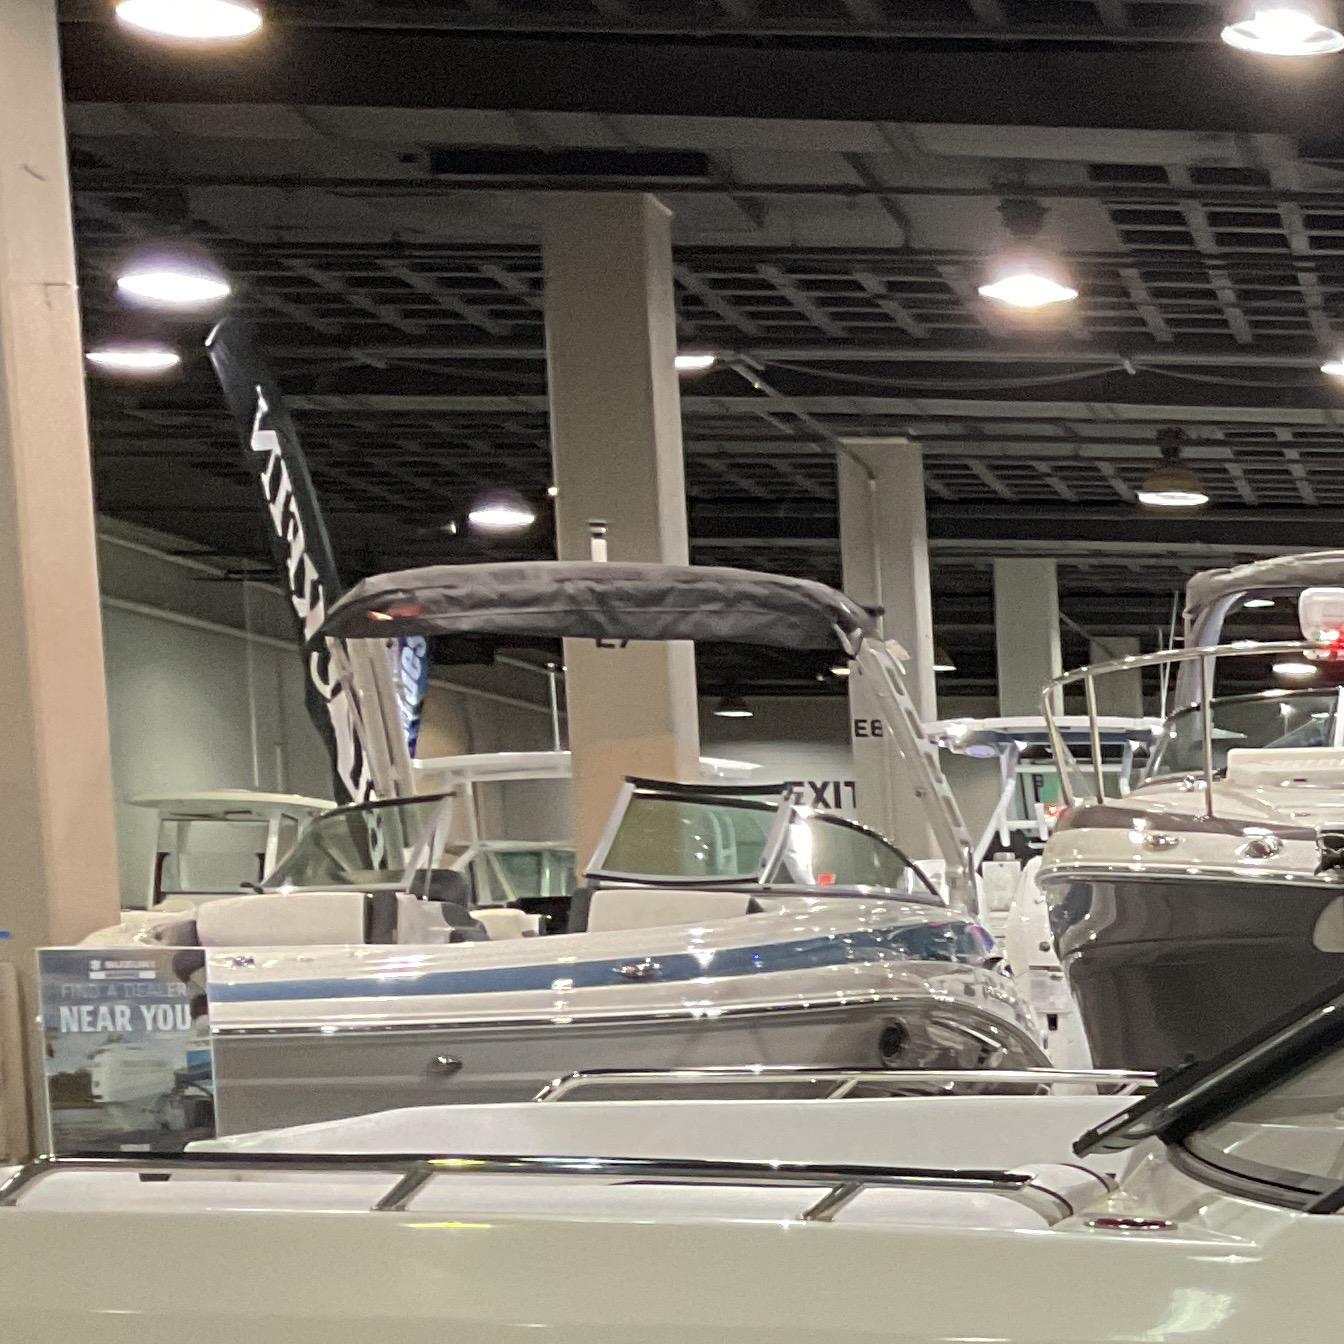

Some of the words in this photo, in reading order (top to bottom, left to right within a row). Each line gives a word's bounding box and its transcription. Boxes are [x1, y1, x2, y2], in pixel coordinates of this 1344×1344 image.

[854, 719, 884, 738] E8
[60, 1004, 132, 1033] NEAR
[139, 1003, 192, 1032] YOU
